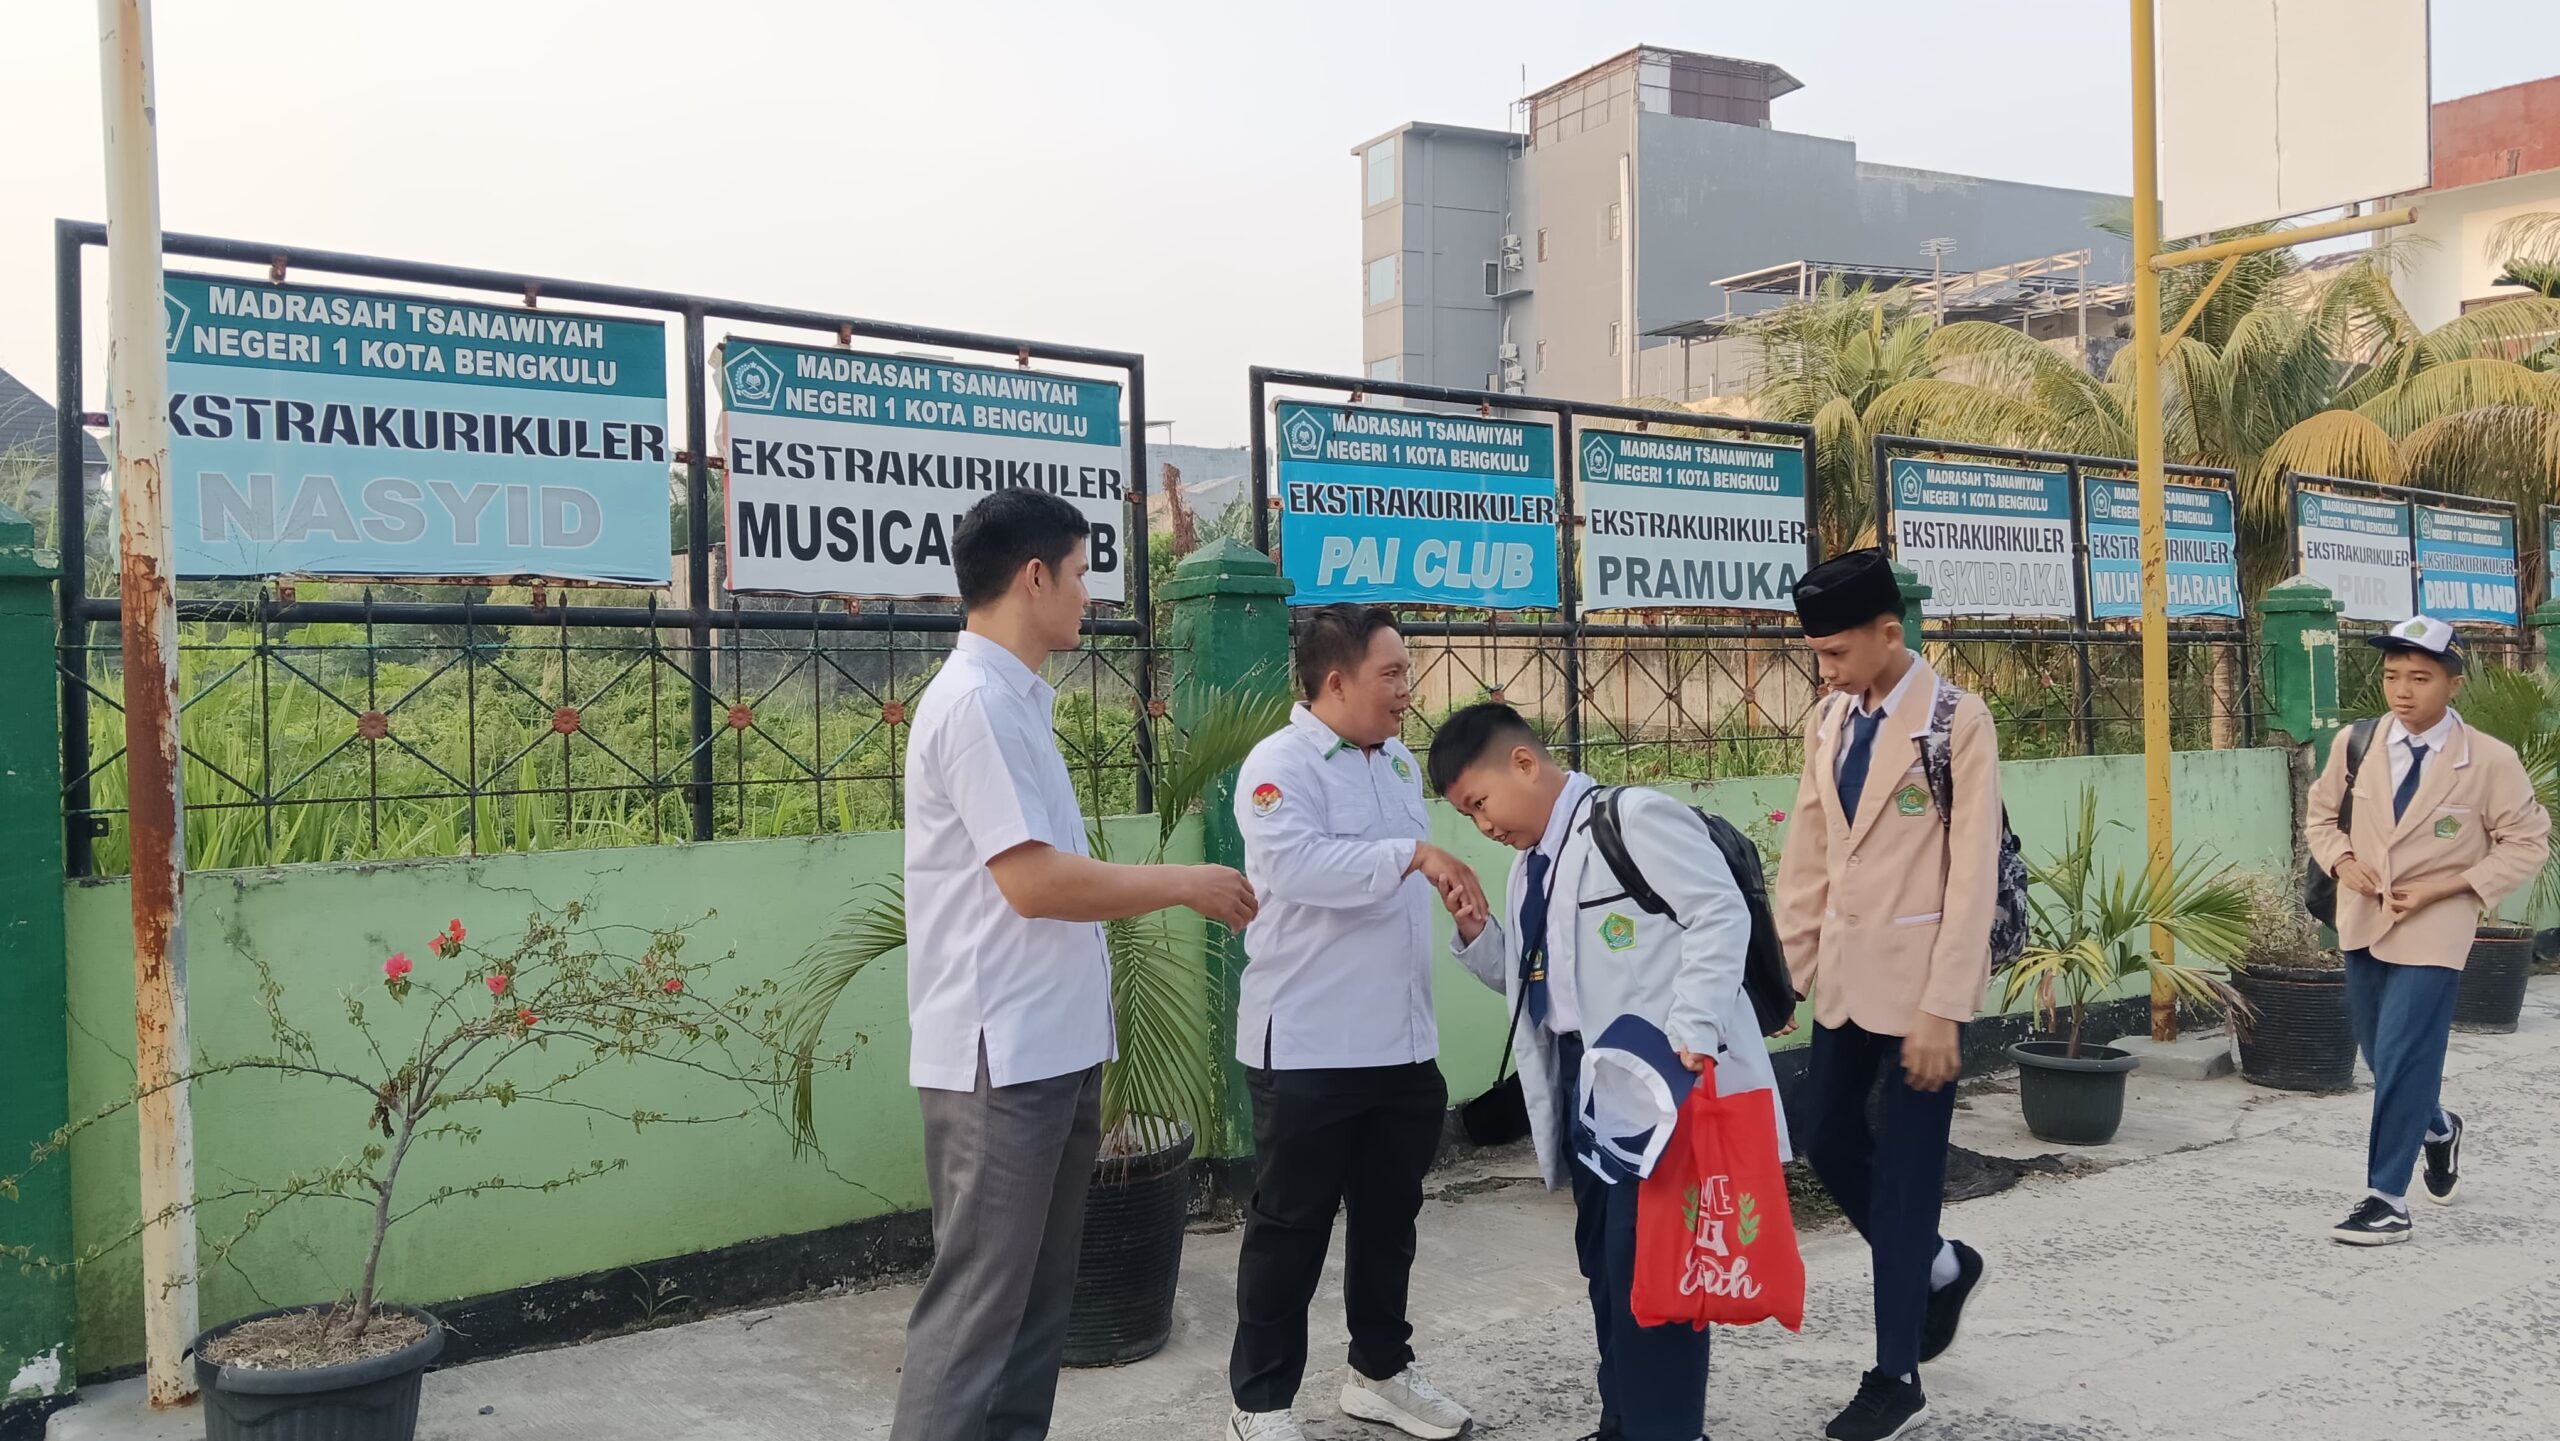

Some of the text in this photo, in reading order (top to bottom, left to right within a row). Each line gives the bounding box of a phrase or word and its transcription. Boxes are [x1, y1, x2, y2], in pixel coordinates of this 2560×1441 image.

[209, 286, 604, 349] MADRASAH TSANAWIYAH
[193, 326, 617, 386] NEGERI 1 KOTA BENGKULU
[797, 354, 1077, 406] MADRASAH TSANAWIYAH
[168, 393, 665, 462] KSTRAKURIKULER
[786, 387, 1088, 438] NEGERI 1 KOTA BENGKULU
[1332, 413, 1523, 446] MADRASAH TSANAWIYAH
[731, 438, 1121, 500] EKSTRAKURIKULER
[1326, 440, 1529, 473] NEGERI 1 KOTA BENGKULU
[1620, 440, 1774, 469] MADRASAH TSANAWIYAH
[1614, 463, 1779, 492] NEGERI 1 KOTA BENGKULU
[1927, 469, 2044, 492] MADRASAH TSANAWIYAH
[200, 472, 603, 548] NASYID
[1289, 483, 1554, 524] EKSTRAKURIKULER
[1922, 490, 2048, 511] NEGERI 1 KOTA BENGKULU
[2165, 491, 2209, 508] SANAWIYAH
[1592, 508, 1806, 545] EKSTRAKURIKULER
[2173, 513, 2213, 526] BENGKULU
[1903, 521, 2064, 553] EKSTRAKURIKULER
[1317, 536, 1534, 589] PAI CLUB
[2307, 541, 2409, 567] EKSTRAKURIKULER
[2424, 551, 2514, 575] EKSTRAKURIKULER
[1598, 555, 1799, 601] PRAMUKA
[2338, 574, 2389, 606] PMR
[2424, 580, 2517, 614] DRUM BAND
